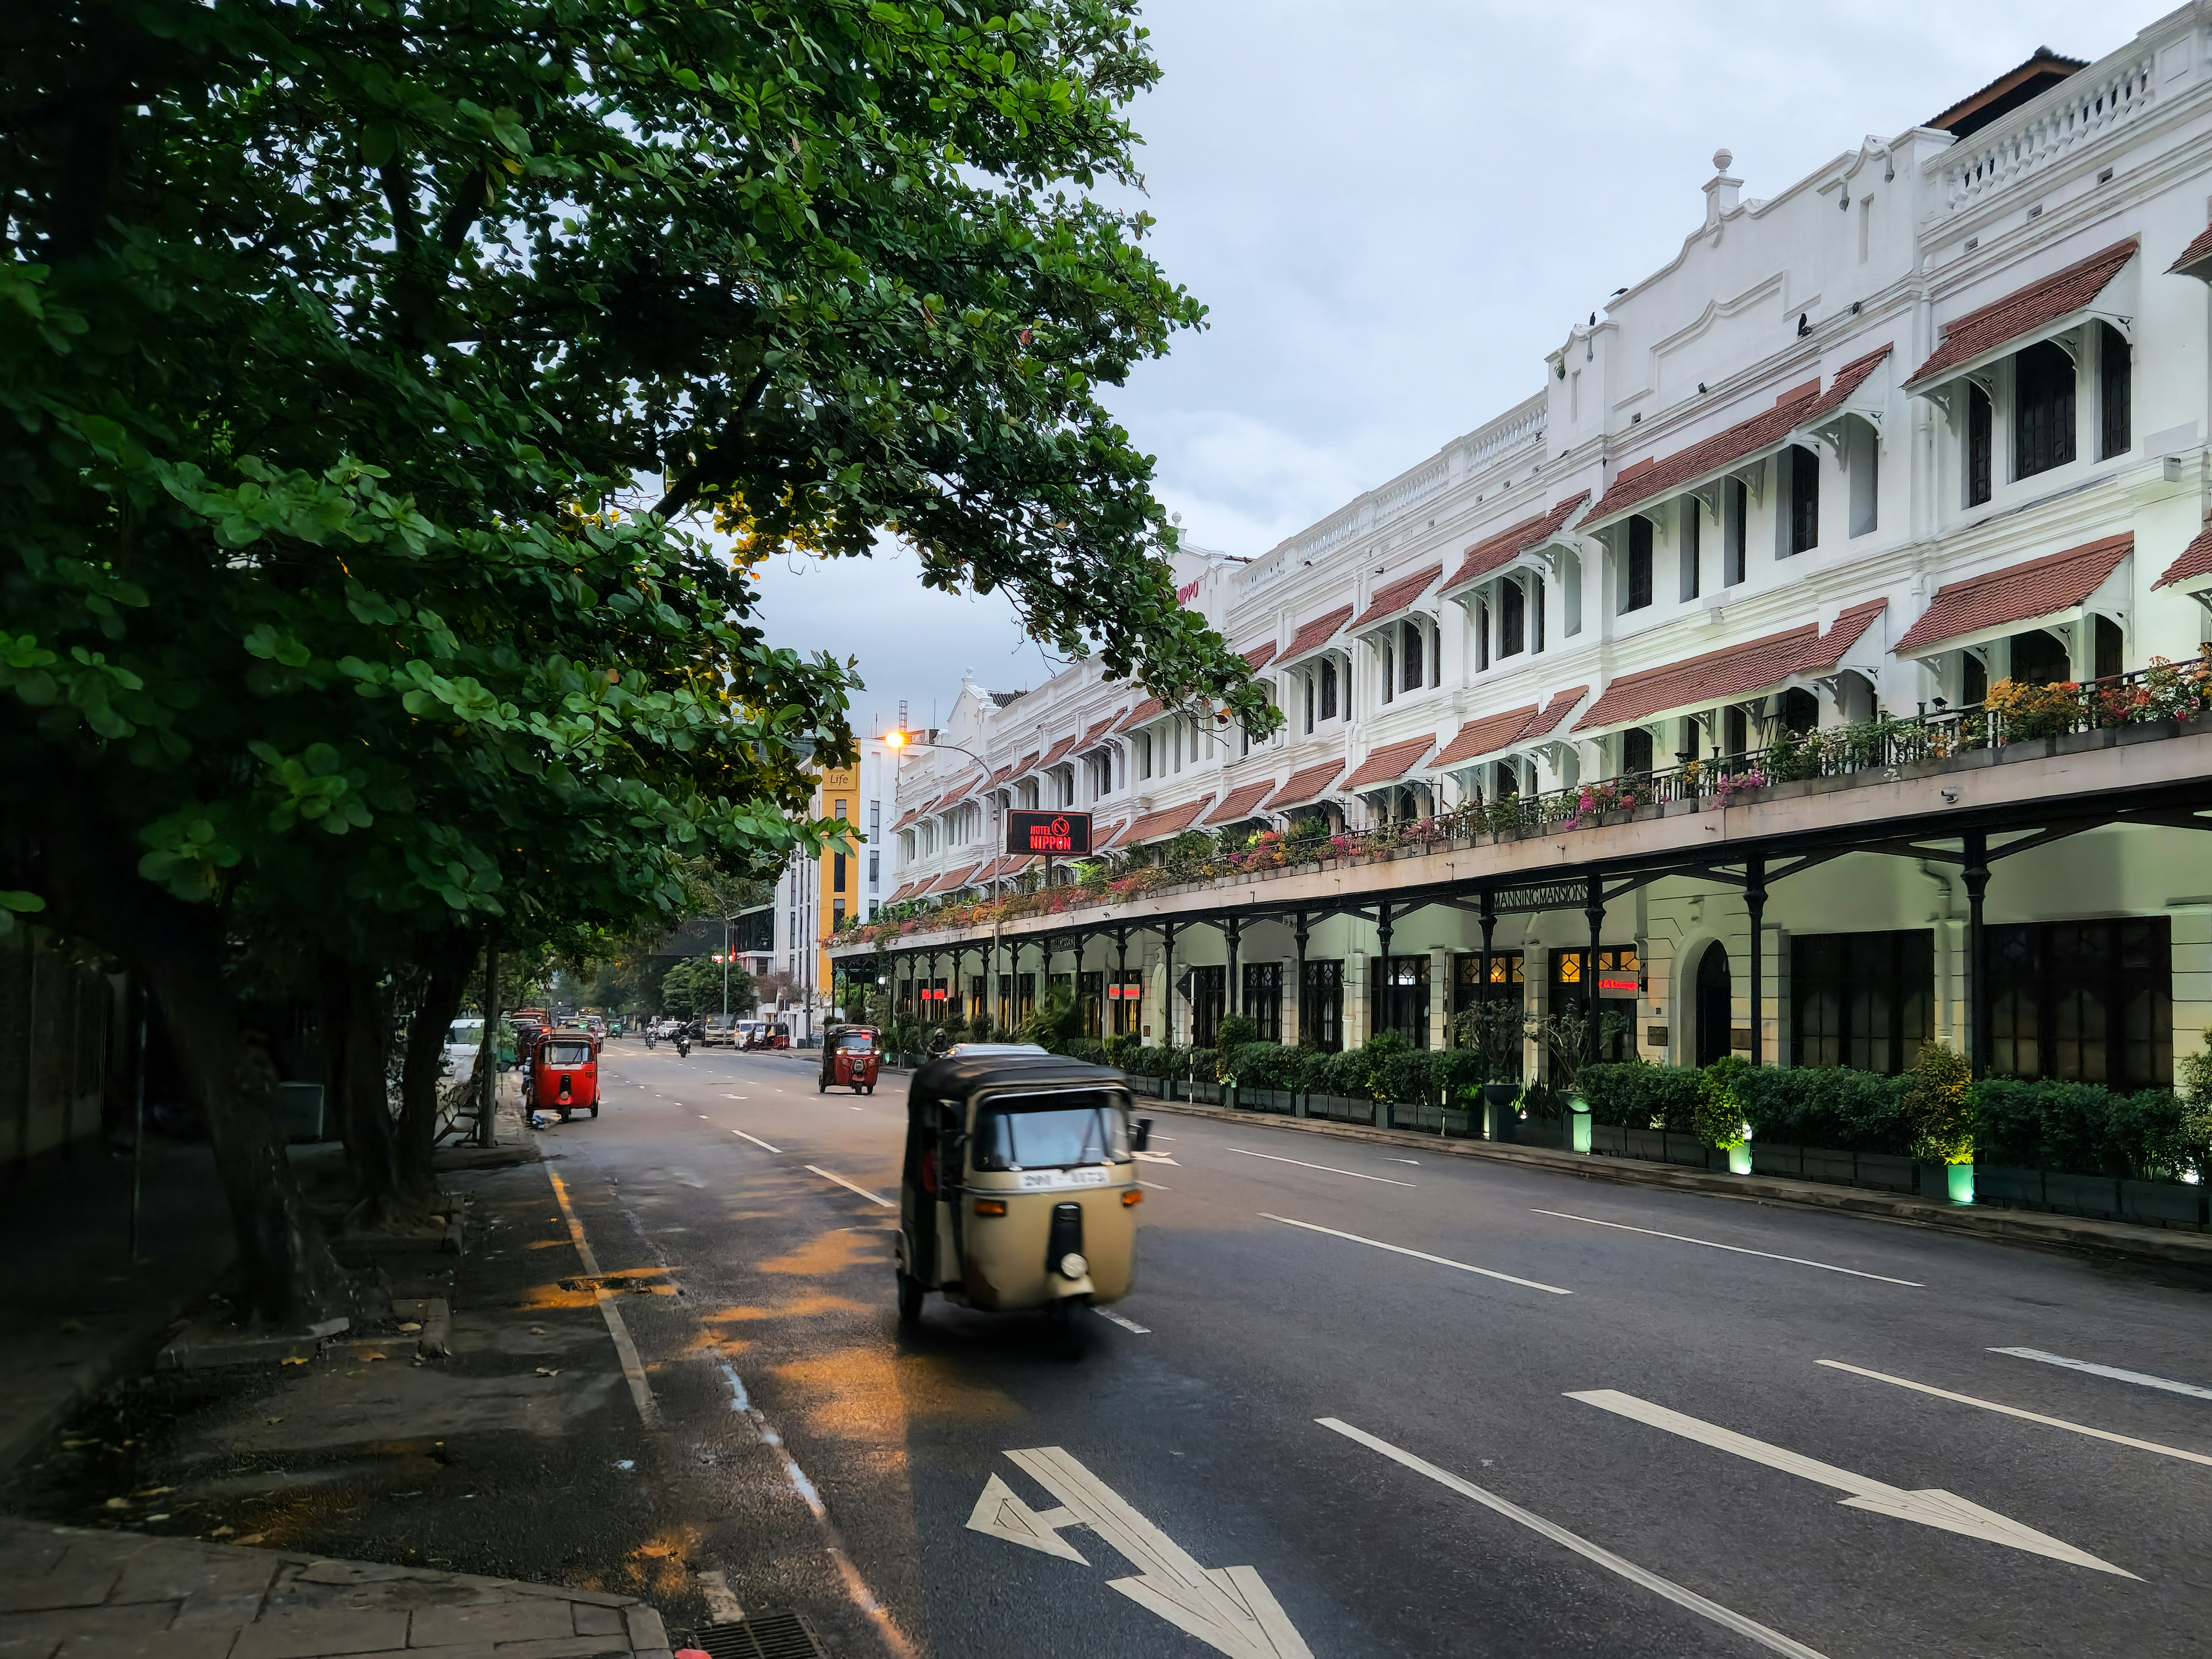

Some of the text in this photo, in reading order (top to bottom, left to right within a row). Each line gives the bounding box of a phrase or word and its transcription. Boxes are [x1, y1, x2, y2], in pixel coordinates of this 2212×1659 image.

[830, 774, 848, 786] Life
[1030, 825, 1053, 835] HOTEL
[1030, 835, 1071, 850] NIPPON
